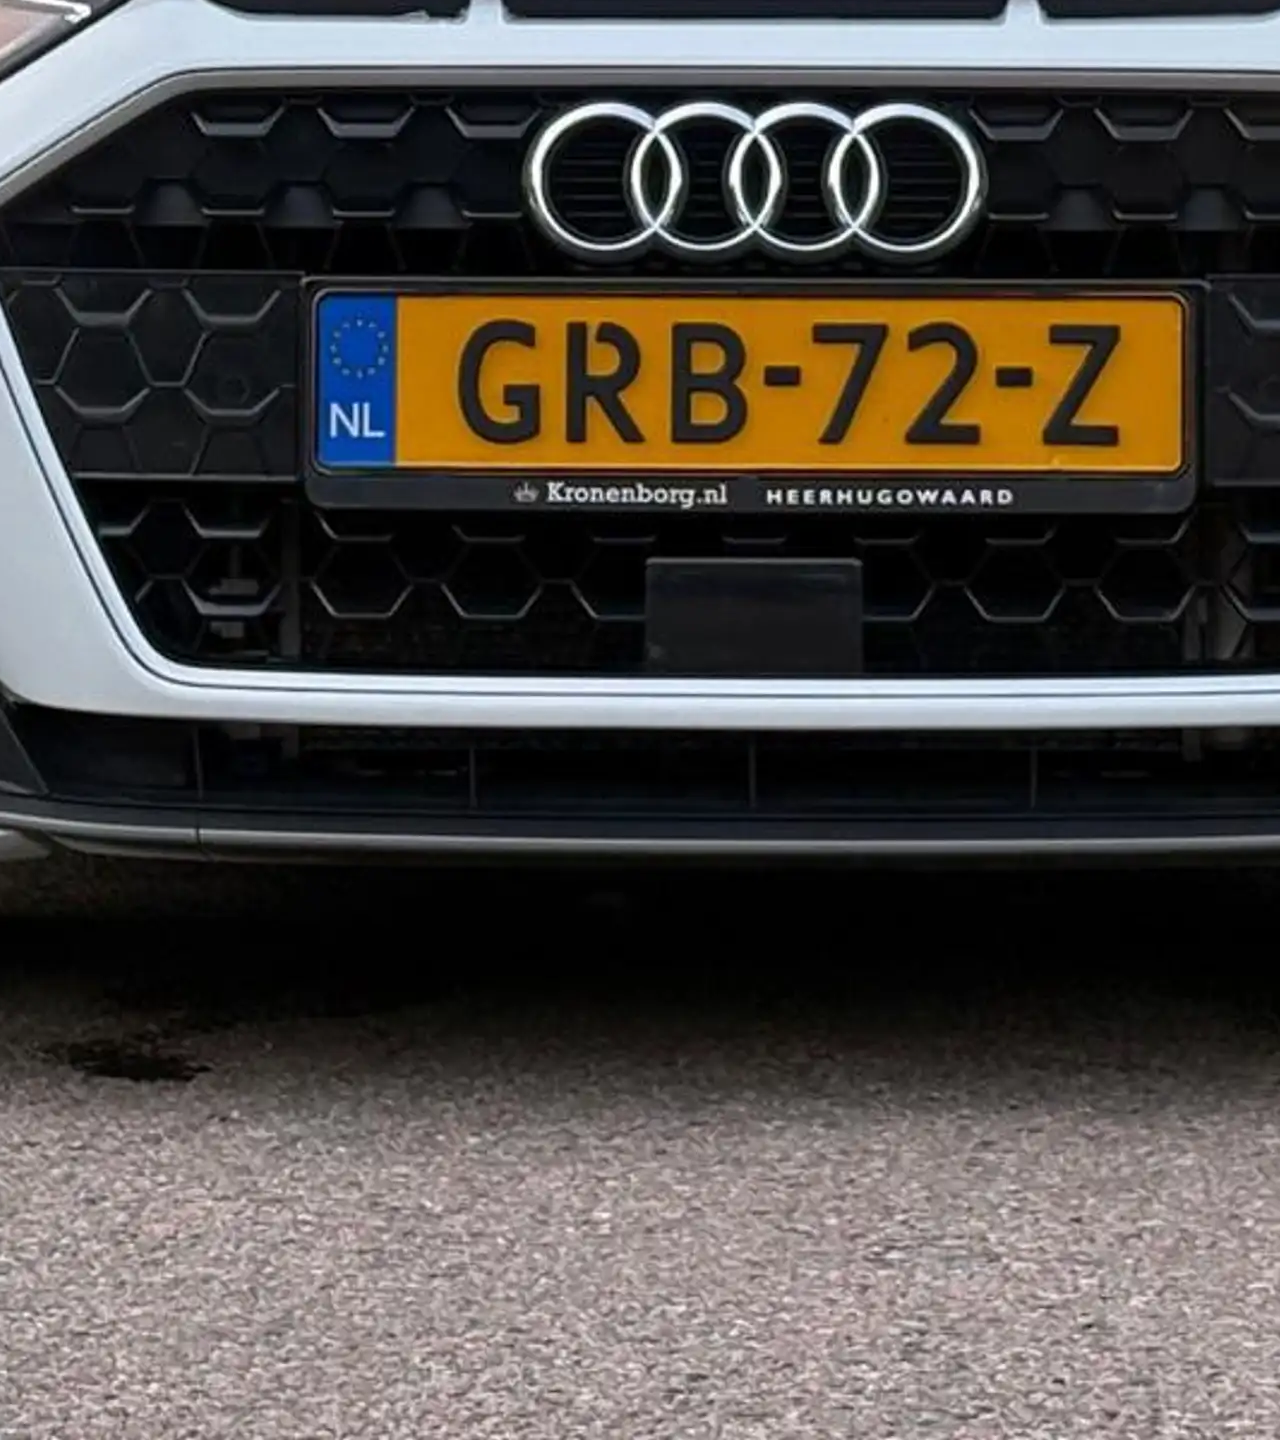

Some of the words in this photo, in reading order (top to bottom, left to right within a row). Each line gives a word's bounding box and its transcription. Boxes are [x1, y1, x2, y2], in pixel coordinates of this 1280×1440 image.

[457, 318, 1120, 446] GRB-72-Z
[328, 401, 385, 438] NL
[546, 480, 728, 508] Kronenborg.nl
[766, 488, 1014, 507] HEERHUGOWAARD
